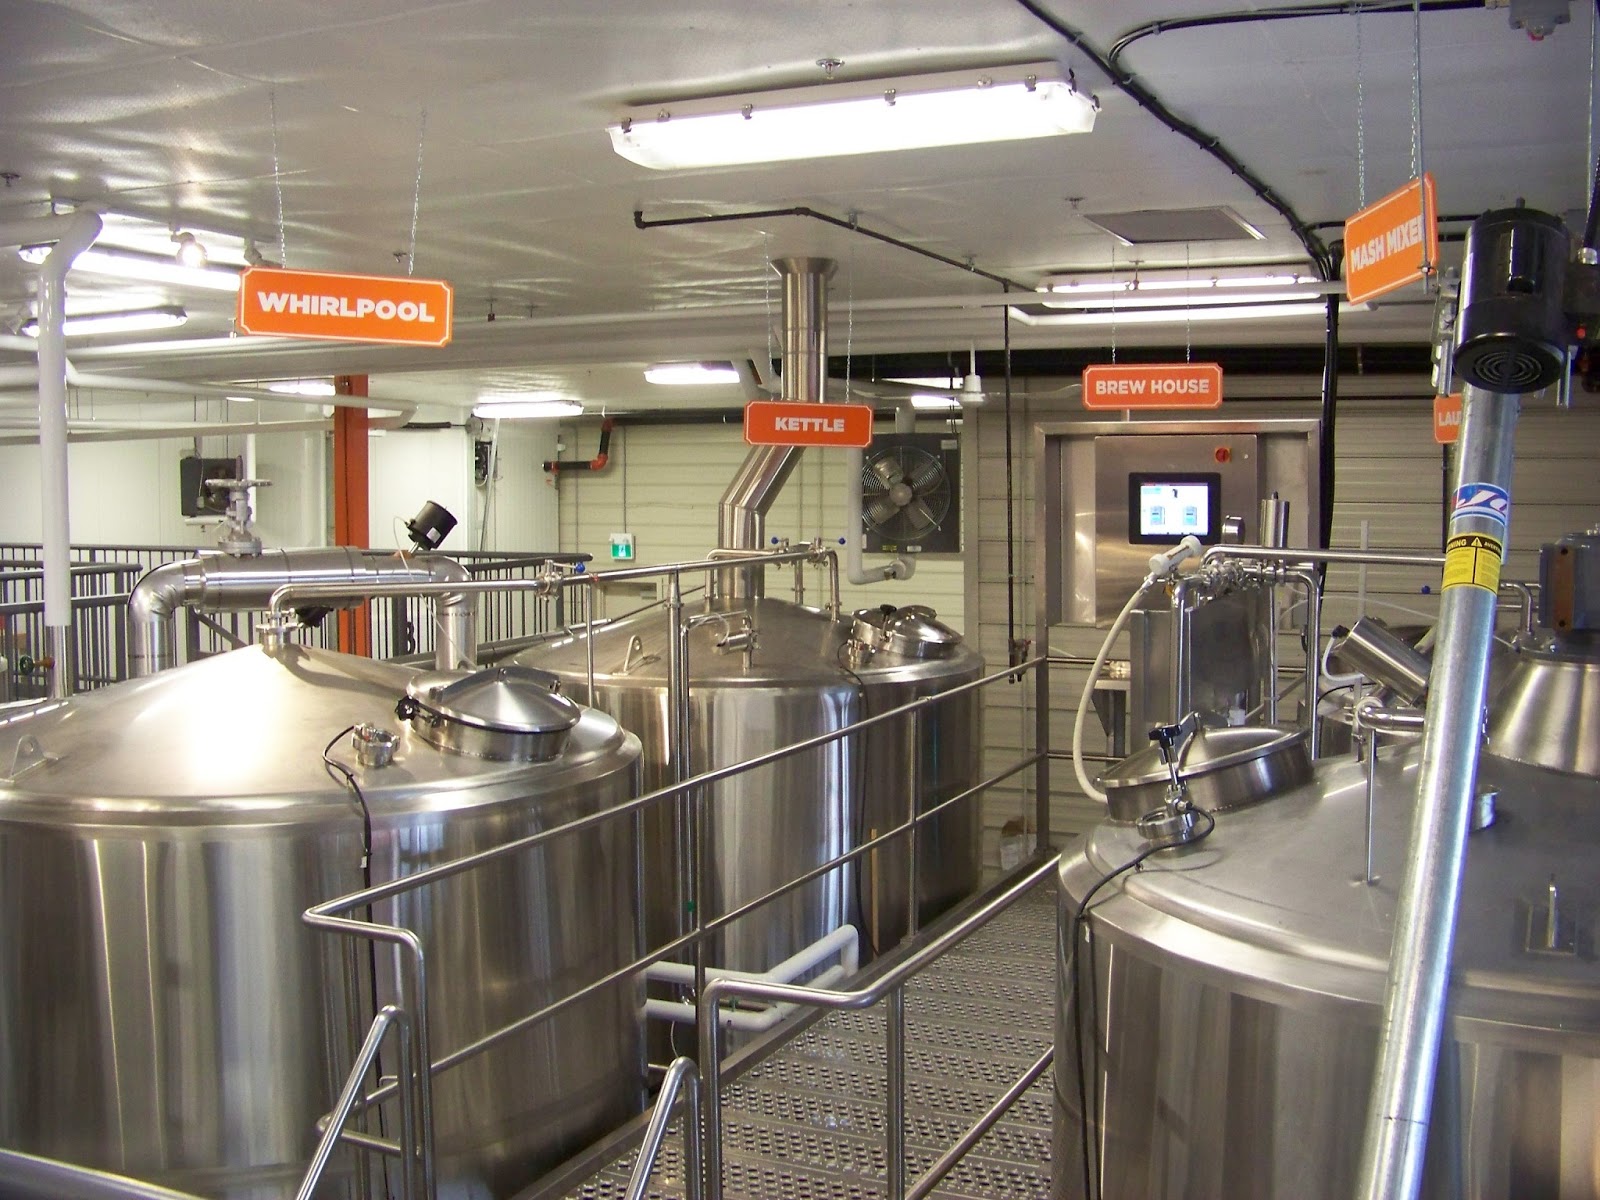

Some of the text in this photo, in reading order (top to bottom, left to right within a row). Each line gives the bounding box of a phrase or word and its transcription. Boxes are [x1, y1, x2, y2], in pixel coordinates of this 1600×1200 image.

[1350, 234, 1385, 273] MASH
[257, 291, 435, 323] WHIRLPOOL
[1095, 379, 1210, 395] BREW HOUSE
[774, 416, 845, 432] KETTLE
[1438, 410, 1462, 427] LAU
